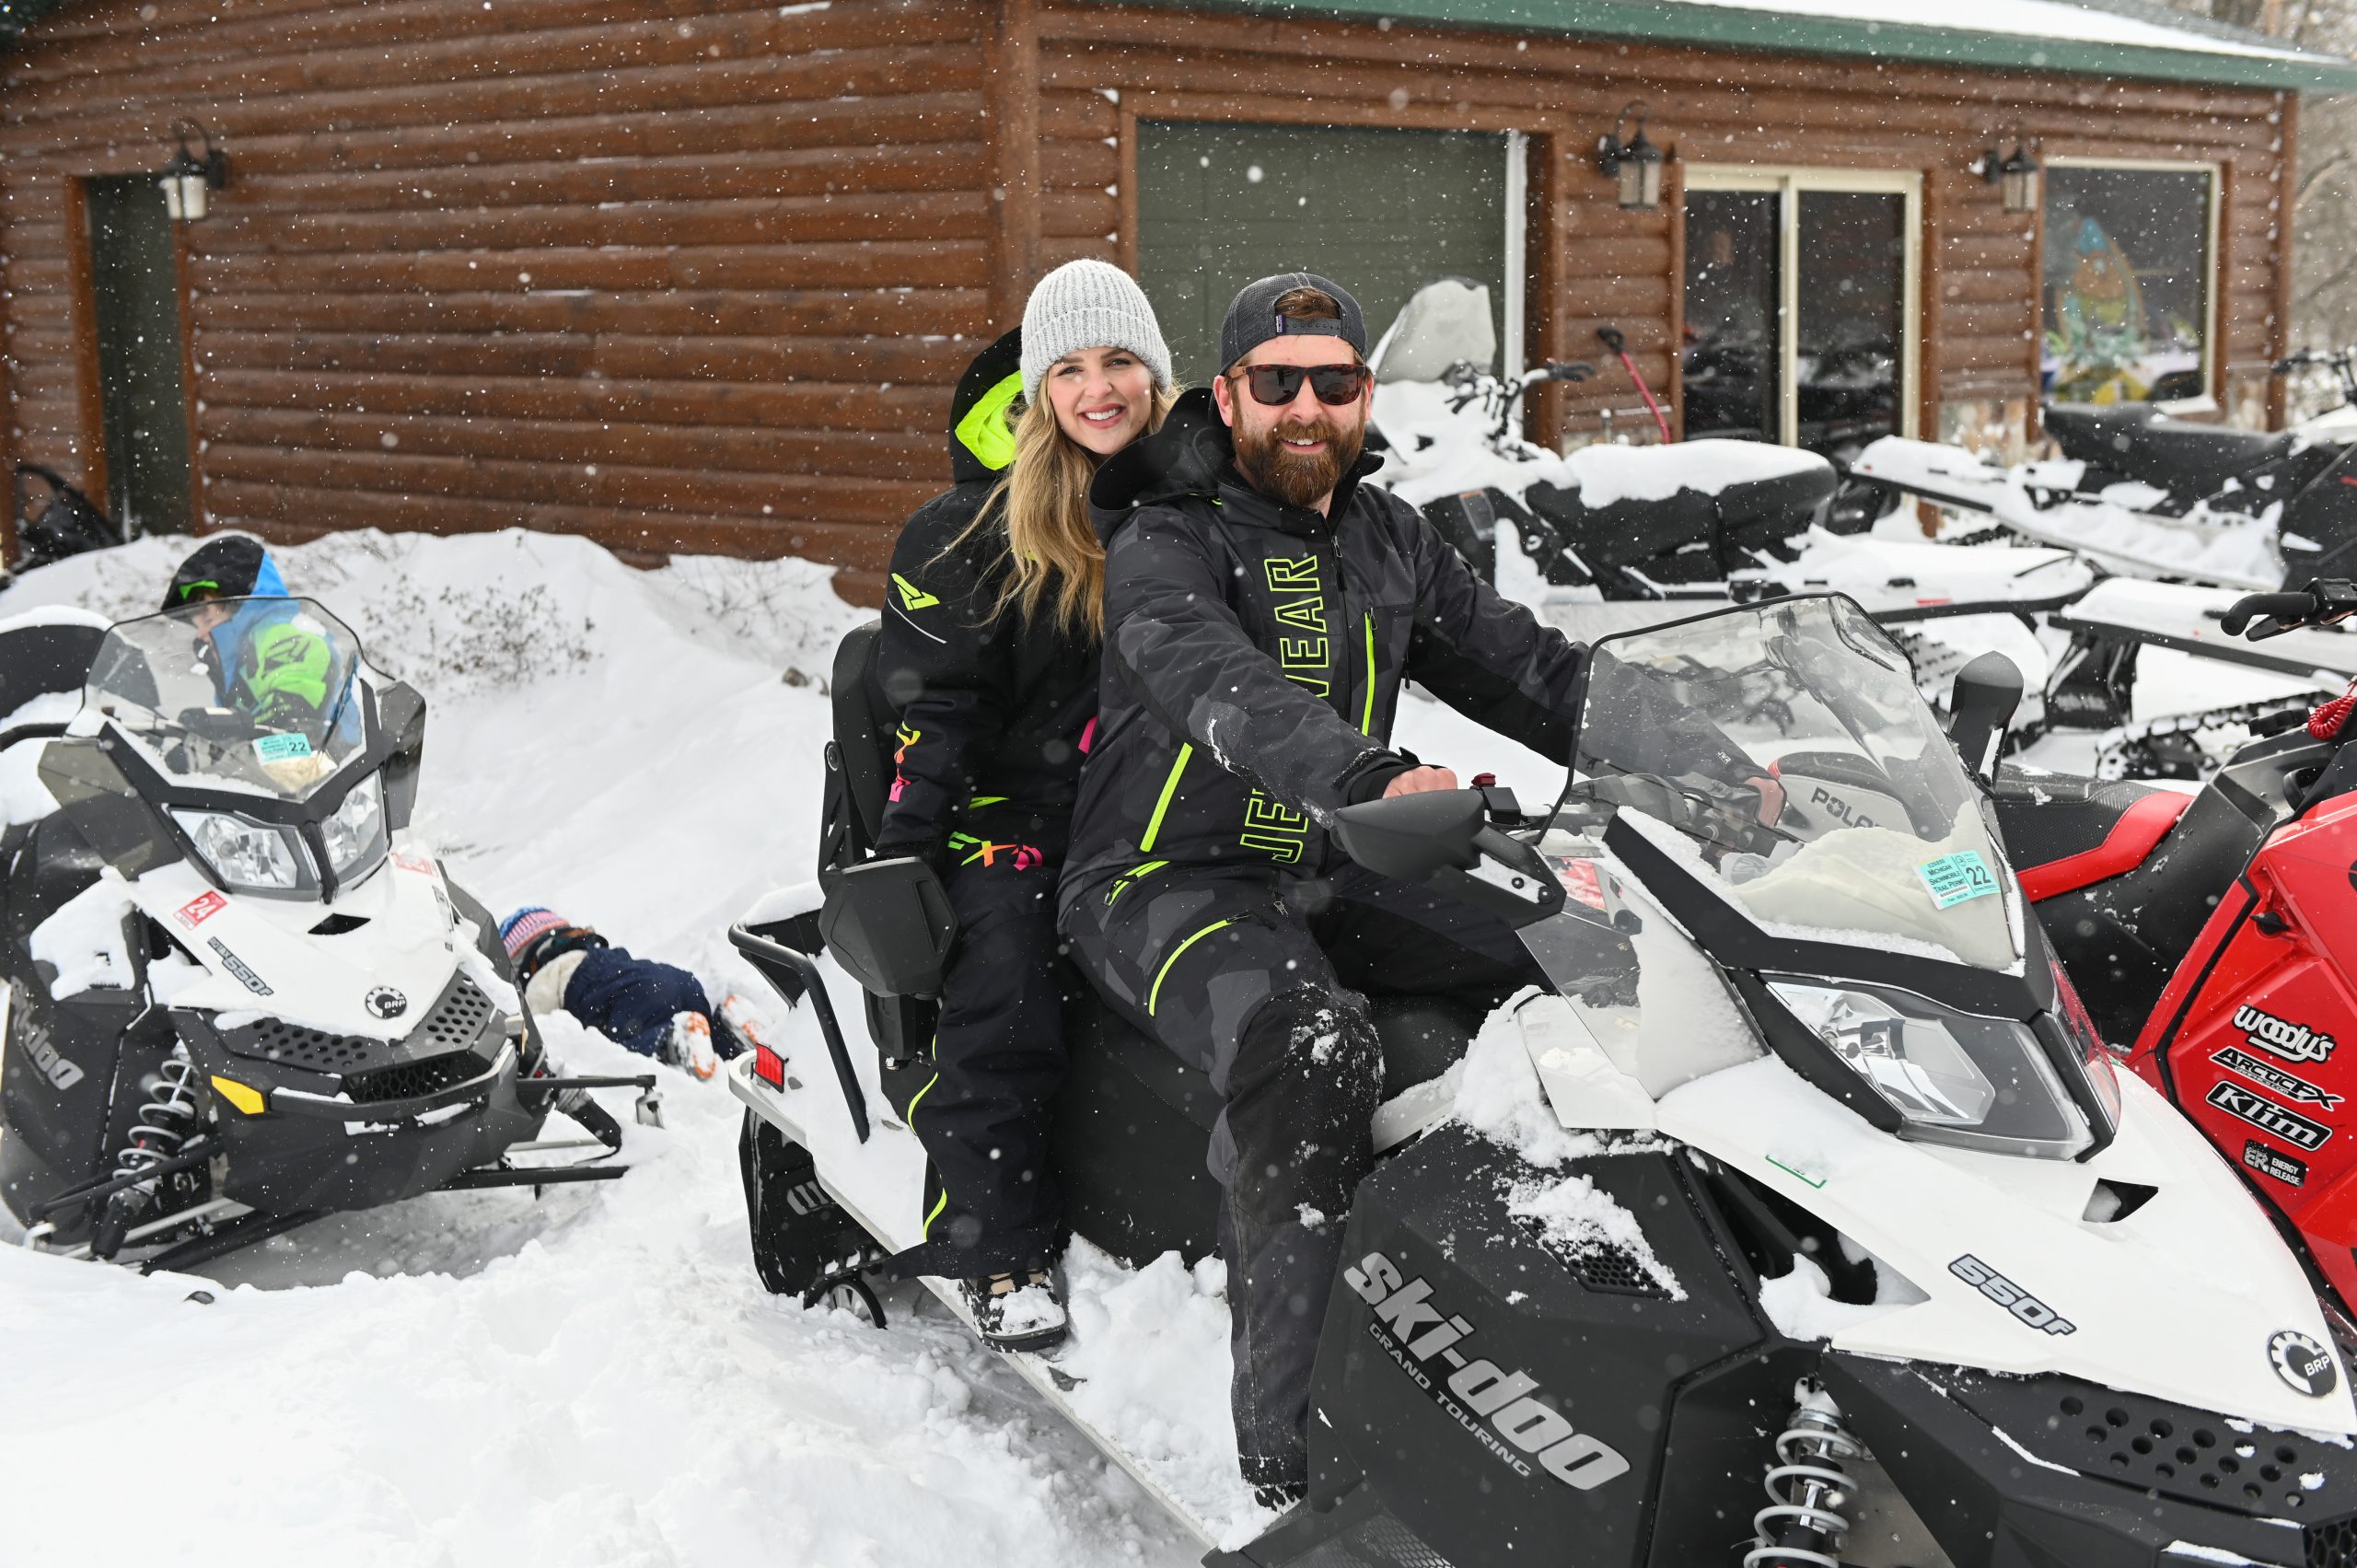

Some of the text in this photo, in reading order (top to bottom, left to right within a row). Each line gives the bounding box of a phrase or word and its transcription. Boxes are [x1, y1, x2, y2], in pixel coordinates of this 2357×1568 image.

[1239, 554, 1330, 865] JEEAR
[289, 741, 307, 752] 22
[1810, 785, 1884, 829] POLA
[1927, 865, 1953, 877] MICHIGAN
[1928, 870, 1962, 886] SNOWMOBILE
[1966, 865, 1991, 886] 22
[1933, 882, 1949, 893] TRAIL
[186, 898, 217, 920] 24
[385, 998, 406, 1009] BRP
[2270, 1156, 2299, 1176] ENERGY
[2269, 1167, 2301, 1187] RELEASE
[1343, 1251, 1631, 1491] ski-doo
[2304, 1355, 2330, 1376] BRP
[1368, 1322, 1532, 1478] GRAND TOURING
